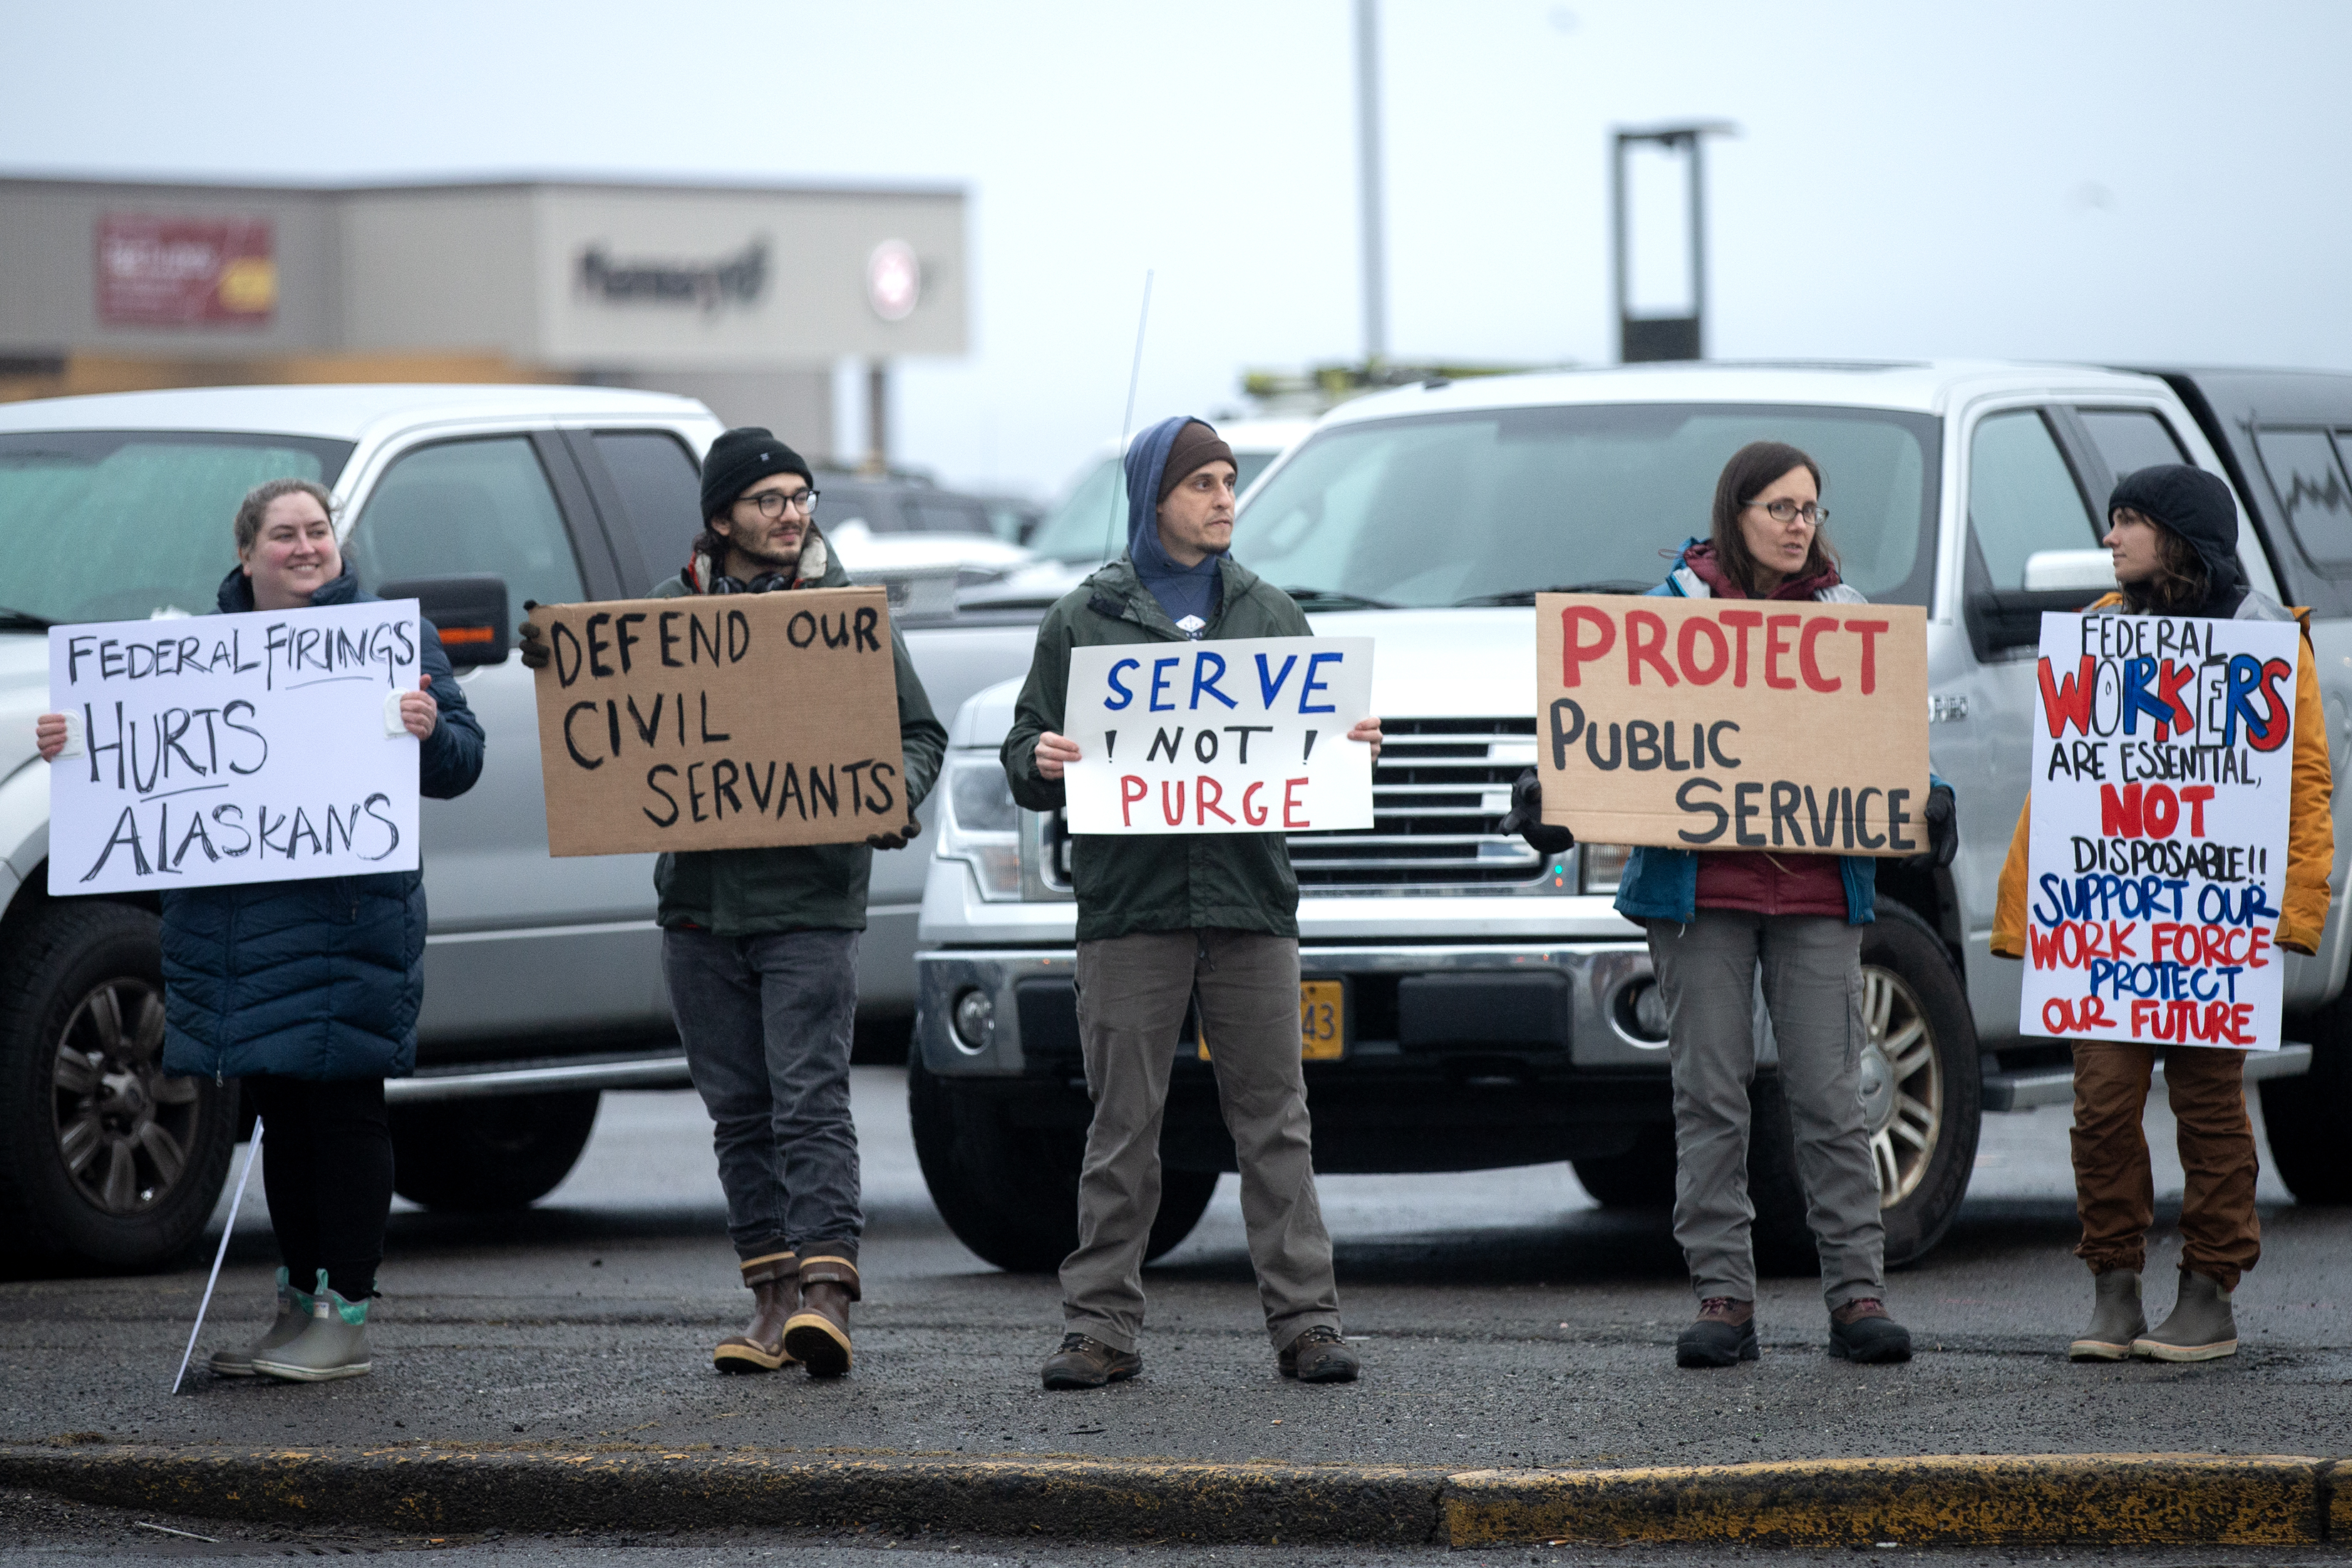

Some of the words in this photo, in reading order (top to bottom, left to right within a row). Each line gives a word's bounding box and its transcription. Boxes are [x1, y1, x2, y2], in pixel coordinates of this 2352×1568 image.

[69, 627, 261, 686] FEDERAL
[265, 619, 415, 691] FIRINGS
[550, 609, 750, 688] DEFEND
[787, 607, 881, 652] OUR
[1561, 605, 1889, 695] PROTECT
[2081, 614, 2228, 662] FEDERAL
[1103, 651, 1343, 713] SERVE
[2037, 654, 2292, 752] WORKERS
[84, 699, 268, 793] HURTS
[564, 691, 731, 770] CIVIL
[1146, 726, 1274, 764] NOT
[1549, 697, 1742, 770] PUBLIC
[643, 758, 895, 827] SERVANTS
[2048, 741, 2109, 781] ARE
[2120, 741, 2261, 789] ESSENTIAL,
[1120, 775, 1310, 828] PURGE
[1676, 777, 1917, 850] SERVICE
[2100, 783, 2215, 840] NOT
[79, 793, 400, 882] ALASKANS
[2070, 836, 2267, 887] DISPOSABLE!!
[2033, 873, 2189, 927] SUPPORT
[2197, 884, 2279, 927] OUR
[2029, 919, 2137, 971] WORK
[2151, 922, 2271, 969] FORCE
[2090, 958, 2244, 1003] PROTECT
[2042, 996, 2118, 1034] OUR
[2131, 999, 2257, 1046] FUTURE
